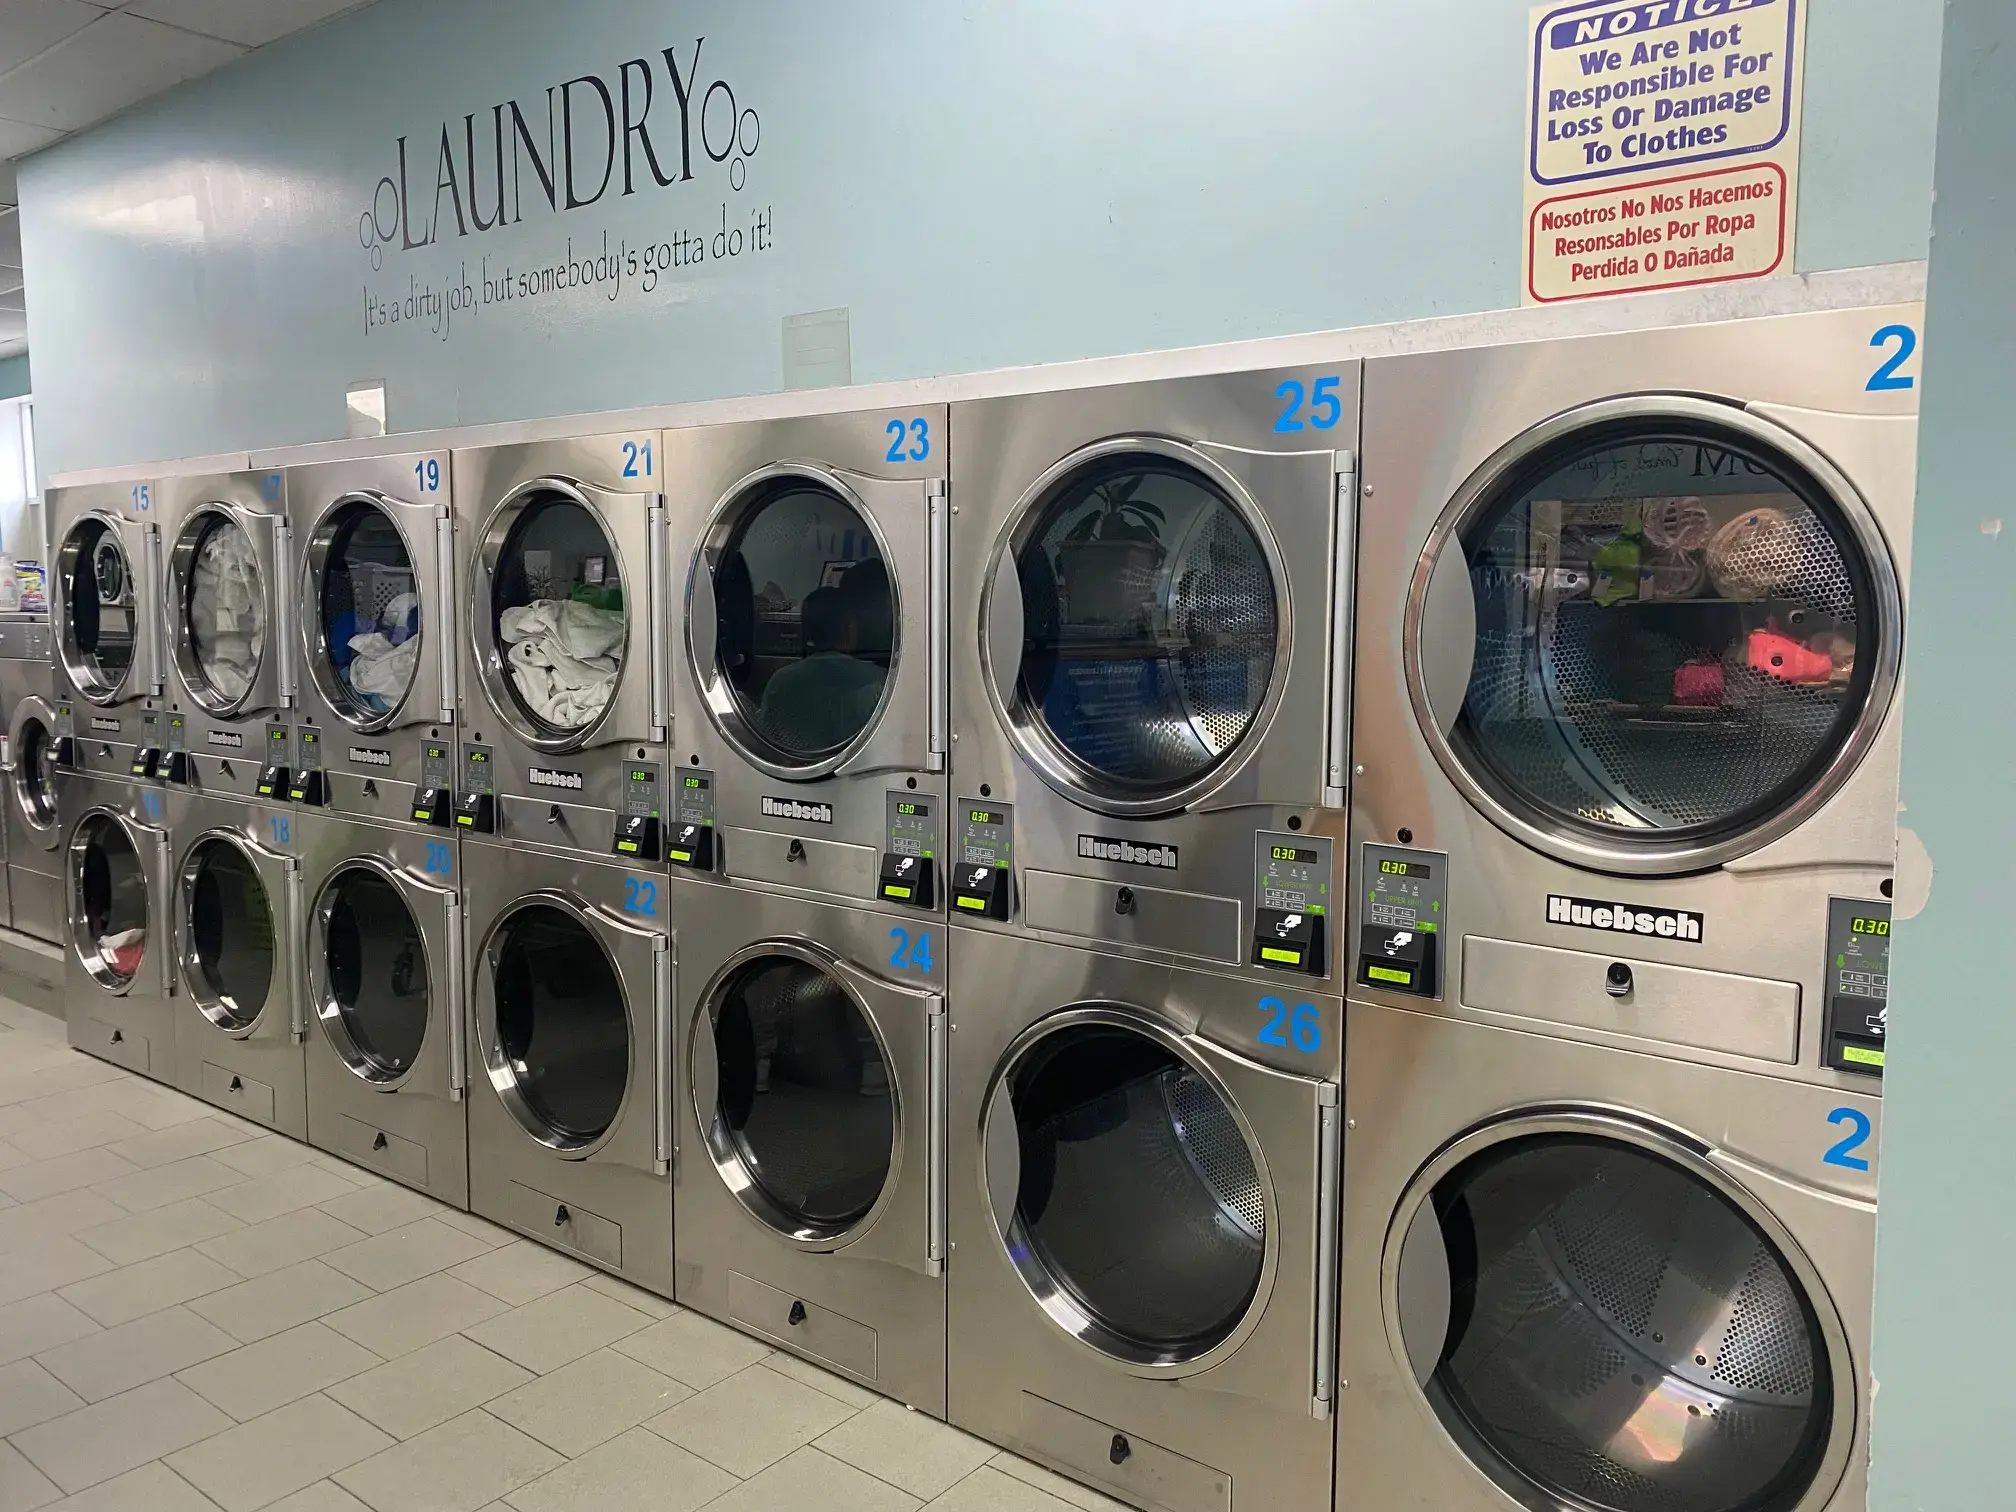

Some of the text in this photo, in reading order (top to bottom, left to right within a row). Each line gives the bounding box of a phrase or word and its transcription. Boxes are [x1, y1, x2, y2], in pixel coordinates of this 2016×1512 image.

[1579, 23, 1741, 76] We Are Not
[1549, 52, 1773, 112] Responsible For
[1548, 85, 1771, 141] Loss Or Damage
[396, 36, 705, 251] LAUNDRY
[1583, 124, 1727, 164] To Clothes
[1541, 181, 1773, 231] Nosotros No Nos Hacemos
[1555, 213, 1755, 257] Resonsables Por Ropa
[363, 202, 772, 341] It's a dirty job, but somebody's gotta do it!
[1571, 242, 1734, 282] Perdida O Dañada
[1272, 376, 1342, 433] 25
[623, 441, 652, 478] 21
[885, 418, 930, 462] 23
[415, 460, 440, 491] 19
[132, 486, 149, 511] 15
[349, 747, 391, 765] Huebsch
[529, 768, 583, 789] Huebsch
[271, 817, 290, 844] 18
[762, 797, 831, 822] Huebsch
[425, 841, 452, 876] 20
[1080, 836, 1176, 868] Huebsch
[624, 877, 658, 917] 22
[1548, 896, 1700, 940] Huebsch
[888, 926, 935, 975] 24
[1256, 995, 1321, 1054] 26
